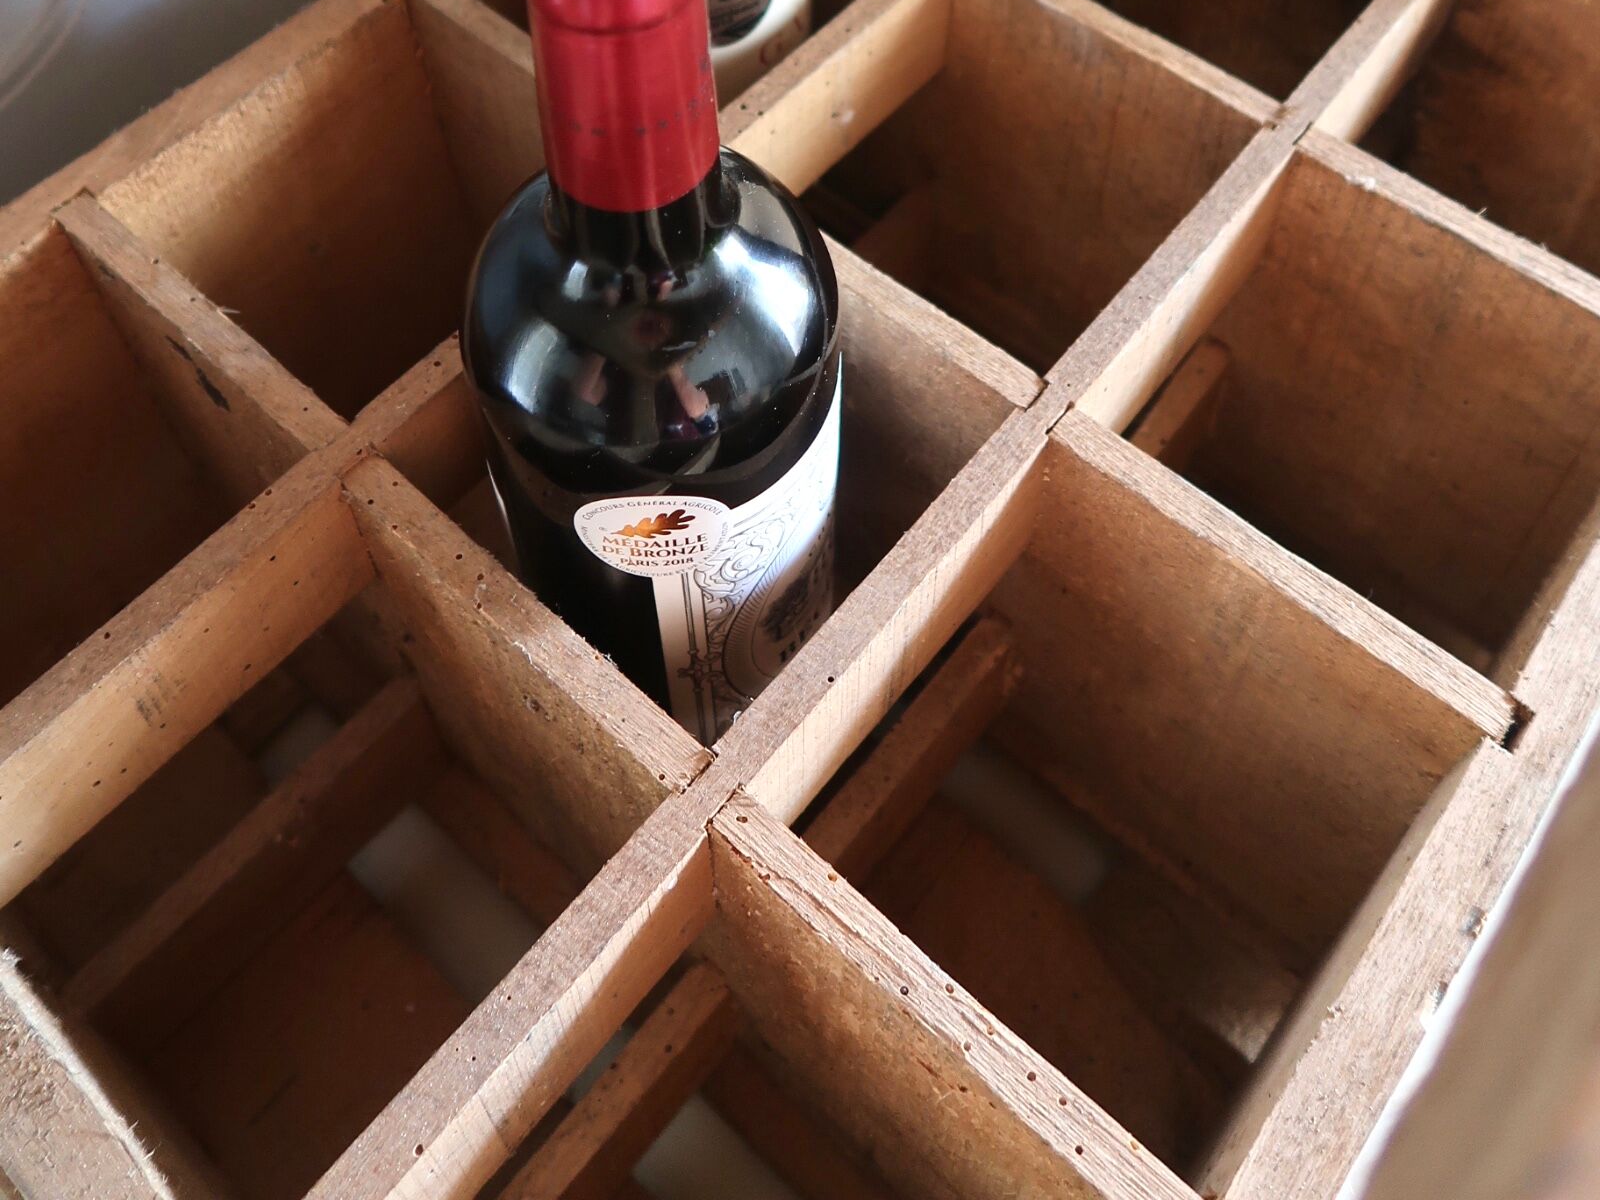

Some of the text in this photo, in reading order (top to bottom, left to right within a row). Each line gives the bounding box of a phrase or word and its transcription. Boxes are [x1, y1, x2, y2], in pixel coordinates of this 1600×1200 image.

[582, 503, 625, 521] CONCOURS
[681, 501, 723, 516] AGRICOLE
[602, 533, 708, 549] MÉDAILLE
[602, 541, 709, 558] DE BRONZE
[620, 557, 694, 567] PARIS 2018
